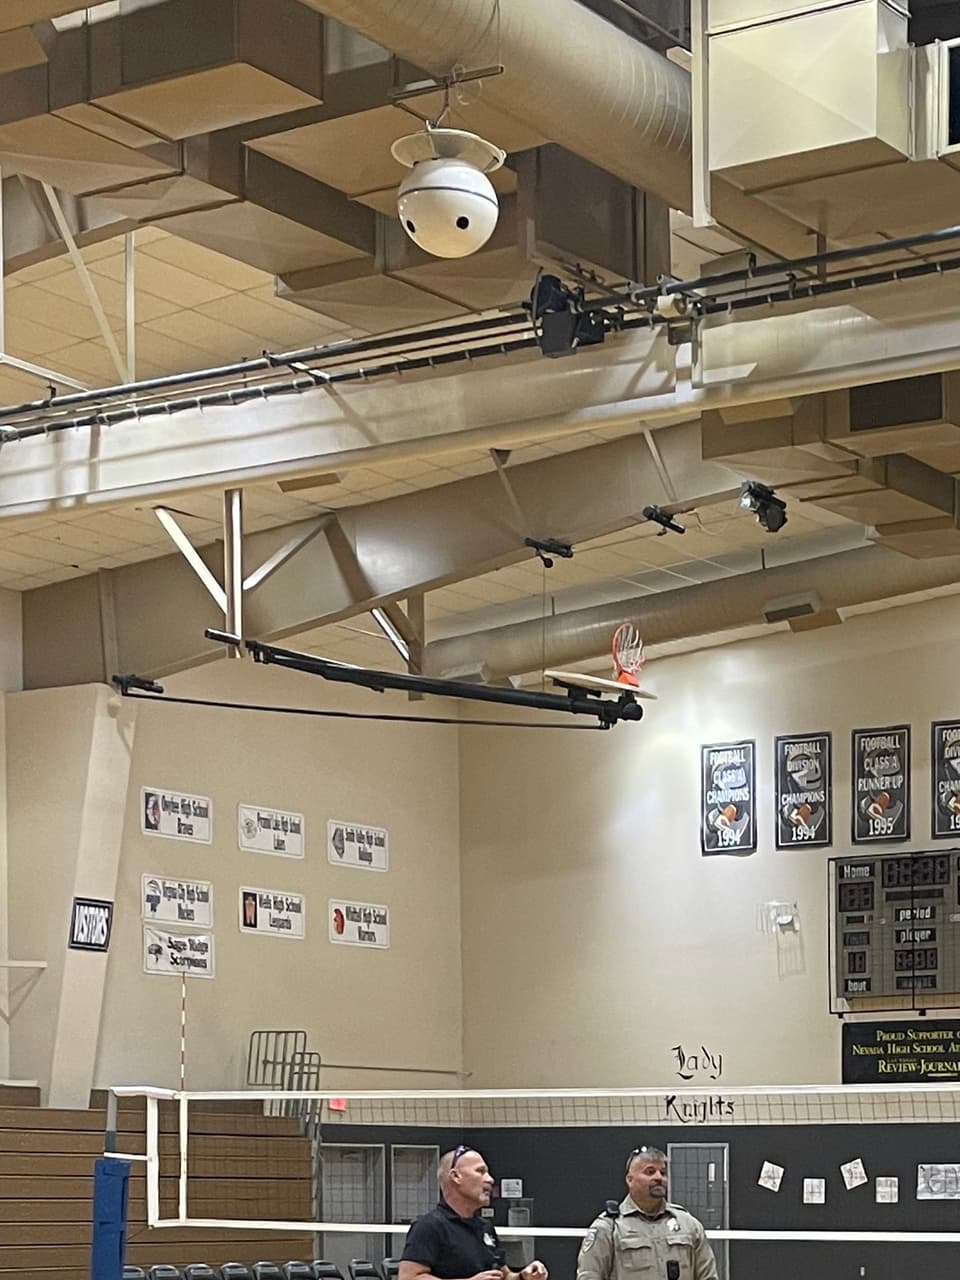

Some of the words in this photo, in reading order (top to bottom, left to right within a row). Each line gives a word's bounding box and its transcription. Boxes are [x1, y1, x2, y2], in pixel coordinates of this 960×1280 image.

[784, 741, 821, 755] FOOTBALL
[860, 735, 901, 751] FOOTBALL
[710, 749, 746, 765] FOOTBALL
[864, 756, 889, 771] CLASS
[787, 759, 820, 772] DIVISION
[707, 788, 749, 804] CHAMPIONS
[781, 791, 825, 805] CHAMPIONS
[792, 825, 816, 840] 1994
[869, 817, 893, 835] 1995
[718, 829, 740, 846] 1994
[843, 865, 870, 878] Home
[900, 906, 931, 921] period
[901, 929, 932, 944] player
[167, 937, 187, 953] Sage
[170, 952, 207, 970] Scorpions
[876, 1029, 905, 1041] PROUD
[907, 1028, 954, 1040] SUPPORTER
[852, 1044, 884, 1055] NEVADA
[887, 1043, 910, 1054] HIGH
[913, 1042, 945, 1054] SCHOOL
[672, 1044, 722, 1080] Lady
[664, 1094, 735, 1123] Knights
